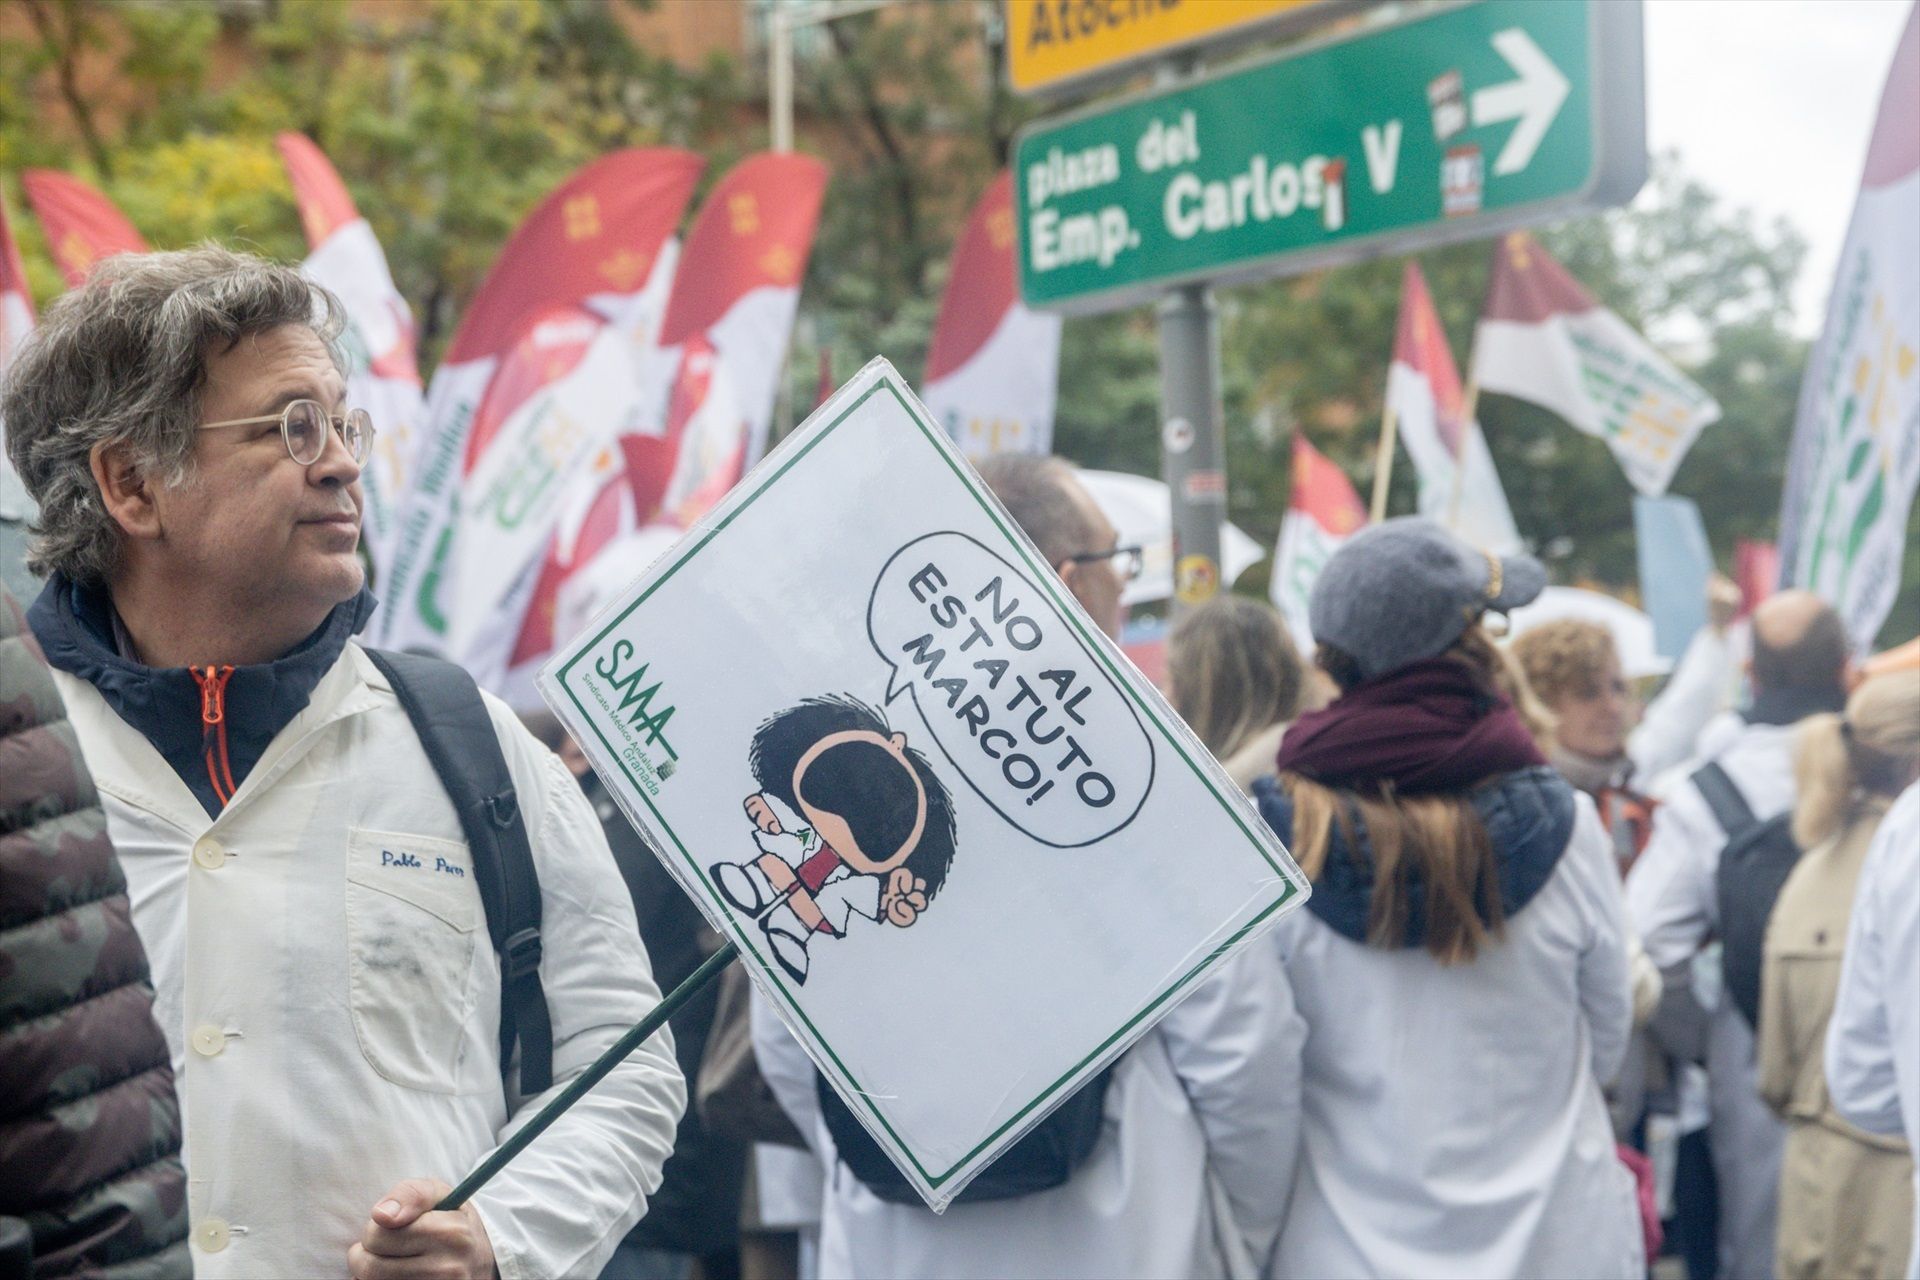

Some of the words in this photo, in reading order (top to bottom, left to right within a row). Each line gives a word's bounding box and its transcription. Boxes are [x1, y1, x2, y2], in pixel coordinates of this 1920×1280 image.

[1026, 0, 1181, 53] Atoc
[1028, 144, 1120, 209] plaza
[1136, 109, 1199, 173] del
[1030, 205, 1141, 271] Emp.
[1163, 154, 1328, 240] Carlos
[1361, 119, 1402, 195] V
[596, 639, 678, 761] SMA
[908, 562, 1116, 808] ESTATUTO
[975, 576, 1042, 651] NO
[1039, 669, 1092, 726] AL
[582, 672, 610, 712] Sindicato
[608, 710, 632, 742] Médico
[630, 741, 657, 774] Andaluz
[622, 748, 660, 796] Granada
[902, 633, 1054, 806] MARCO!
[381, 850, 421, 868] Pablo
